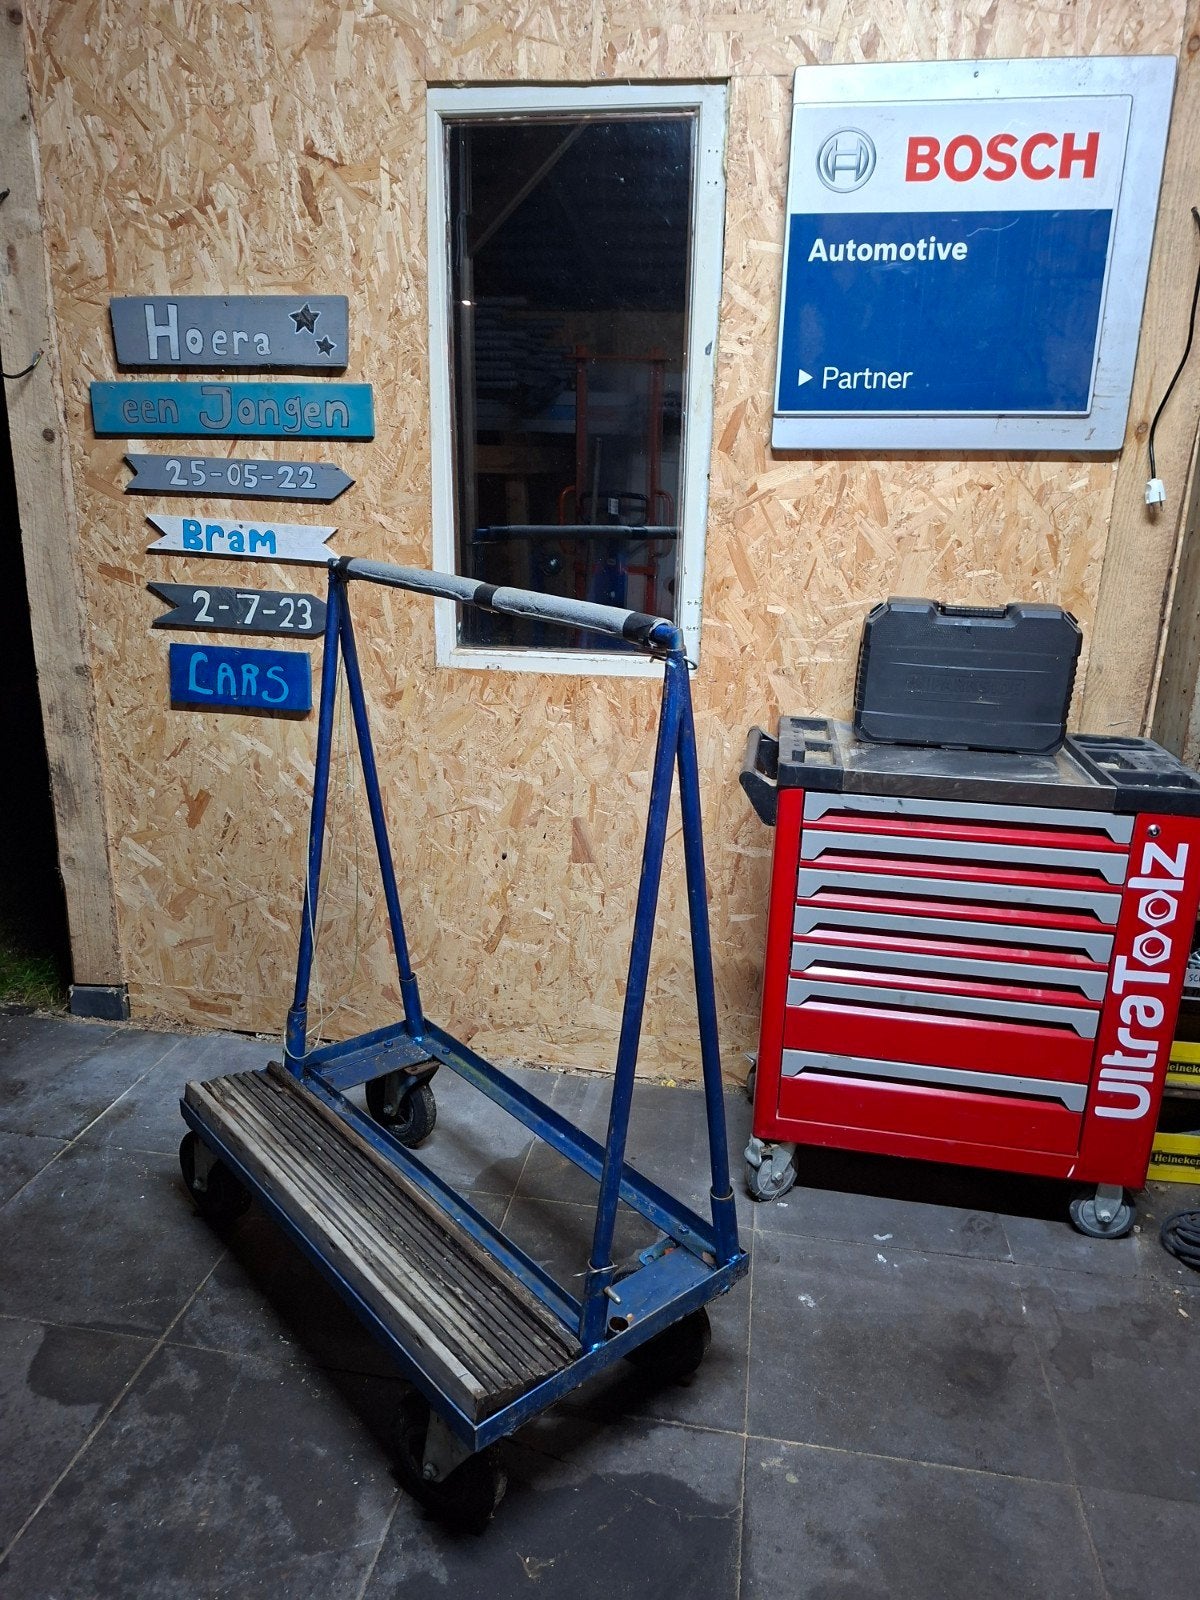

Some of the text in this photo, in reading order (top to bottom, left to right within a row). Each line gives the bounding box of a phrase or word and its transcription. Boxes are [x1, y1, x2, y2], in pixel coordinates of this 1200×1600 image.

[904, 131, 1101, 183] BOSCH
[807, 236, 969, 263] Automotive
[143, 303, 272, 362] Hoera
[821, 366, 914, 390] Partner
[122, 385, 350, 434] een Jongen
[165, 458, 318, 490] 25-05-22
[182, 518, 277, 555] Bram
[188, 651, 290, 704] CARS
[1094, 841, 1190, 1121] UltraToolz
